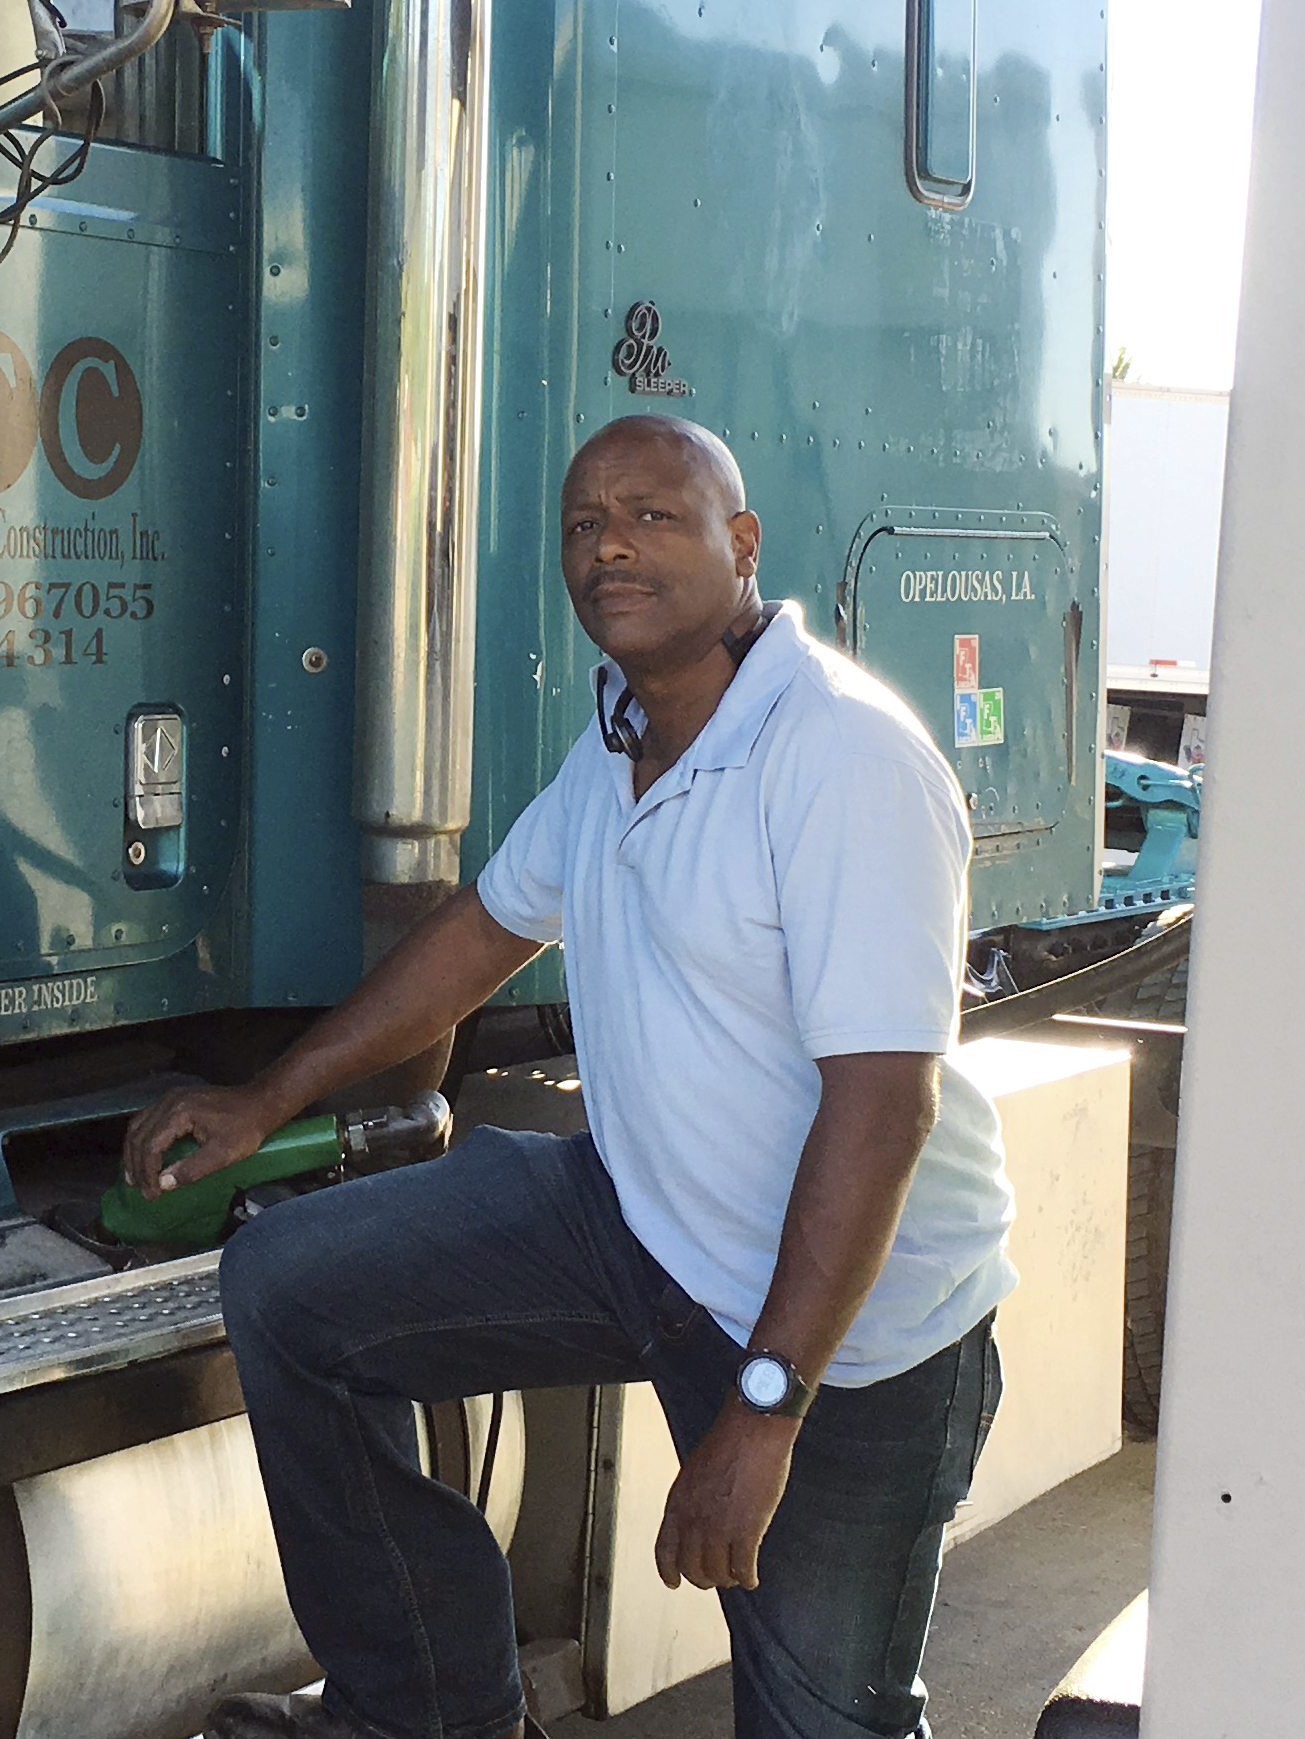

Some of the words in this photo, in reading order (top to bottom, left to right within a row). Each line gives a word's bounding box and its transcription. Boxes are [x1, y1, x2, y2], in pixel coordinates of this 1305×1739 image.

[636, 377, 688, 395] SLEEPER
[131, 511, 166, 562] Inc.
[900, 569, 1006, 604] OPELOUSAS,
[1011, 570, 1036, 601] LA.
[31, 976, 98, 1011] INSIDE
